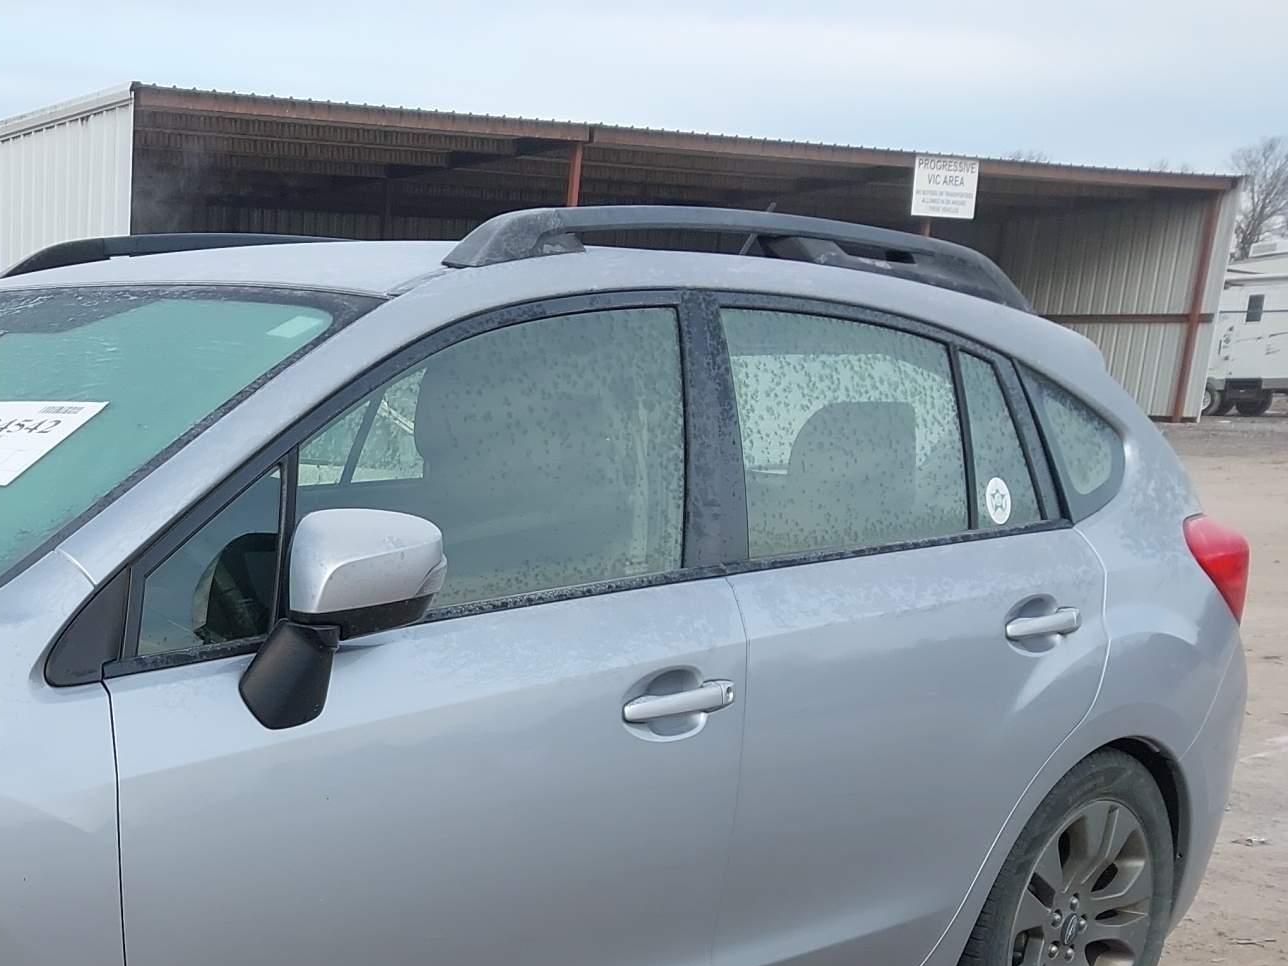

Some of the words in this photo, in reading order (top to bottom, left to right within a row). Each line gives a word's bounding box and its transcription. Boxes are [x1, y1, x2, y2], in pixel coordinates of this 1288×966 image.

[919, 158, 977, 174] PROGRESSIVE
[928, 174, 941, 185] VIC
[942, 175, 964, 187] AREA
